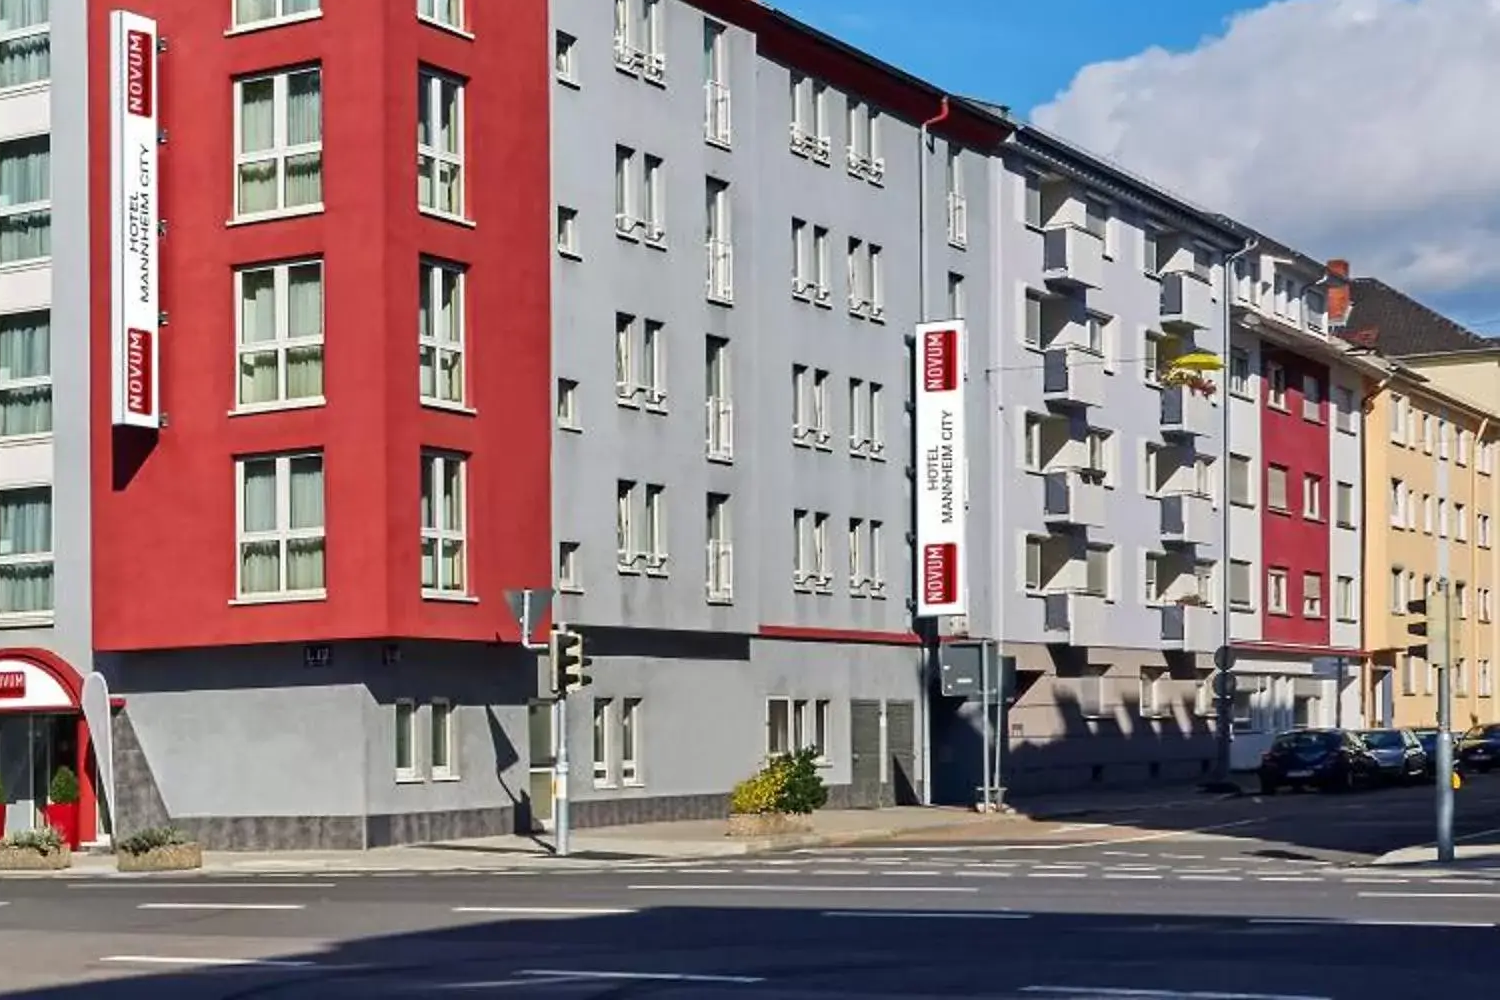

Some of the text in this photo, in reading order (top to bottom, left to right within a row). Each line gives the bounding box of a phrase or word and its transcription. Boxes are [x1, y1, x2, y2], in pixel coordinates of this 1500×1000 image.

[129, 34, 143, 112] NOVUM
[129, 191, 139, 253] HOTEL
[140, 143, 150, 303] MANNHEIM CITY
[129, 330, 143, 410] NOVUM
[927, 333, 943, 389] NOVUM
[927, 445, 938, 491] HOTEL
[941, 409, 953, 524] MANNHEIM CITY
[927, 547, 943, 602] NOVUM
